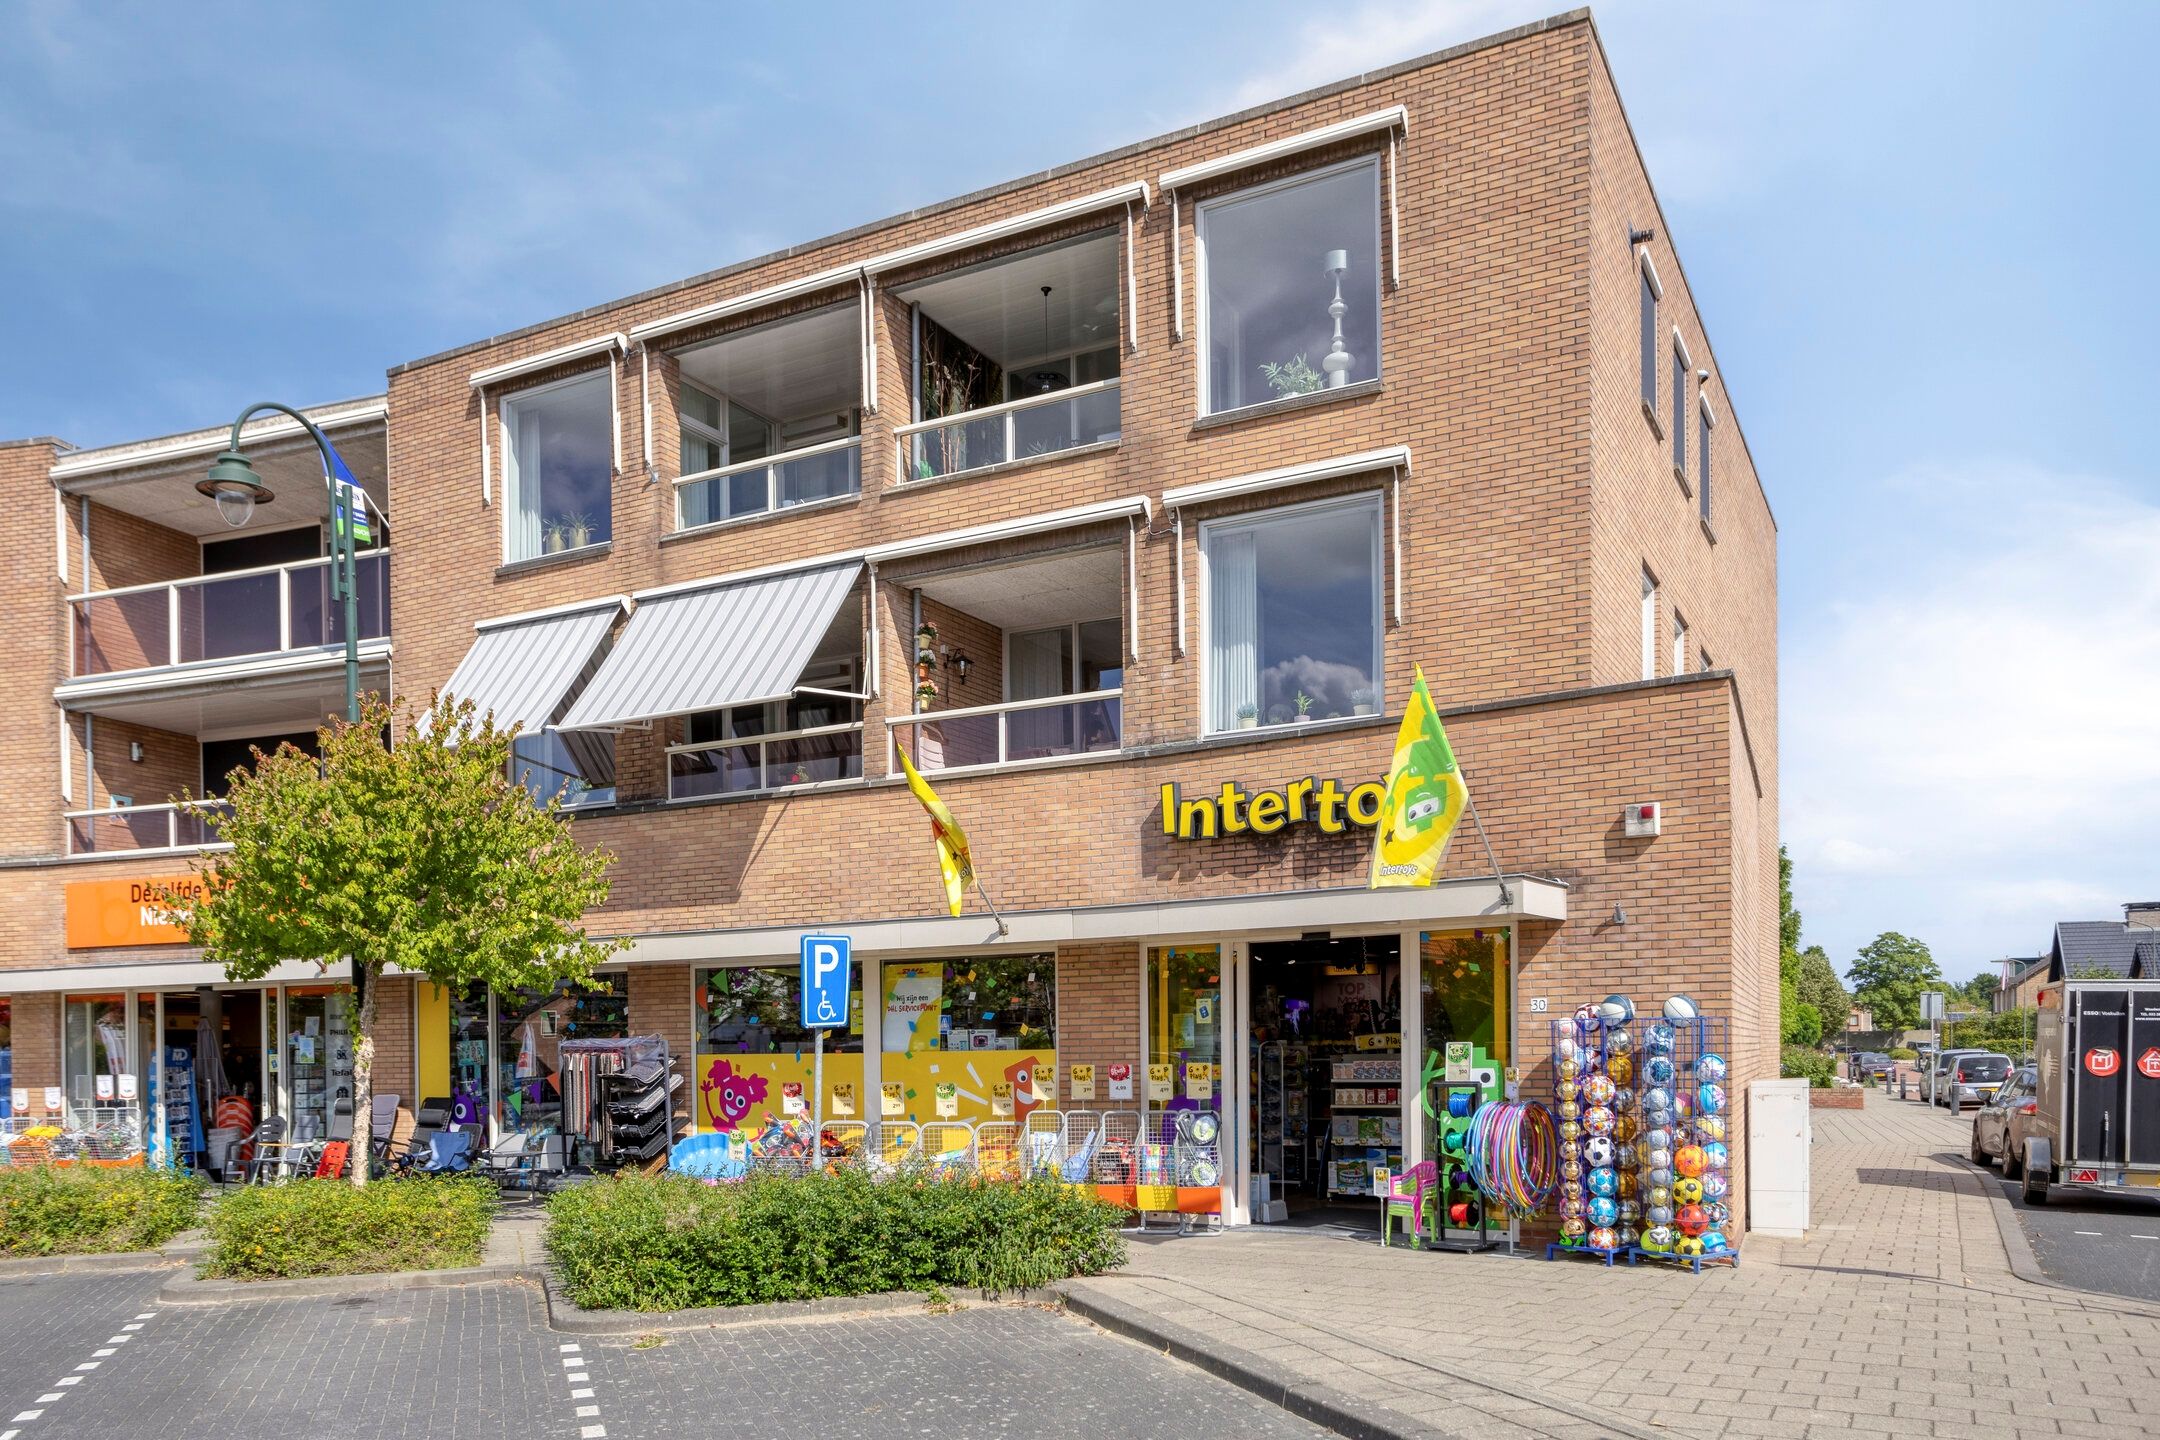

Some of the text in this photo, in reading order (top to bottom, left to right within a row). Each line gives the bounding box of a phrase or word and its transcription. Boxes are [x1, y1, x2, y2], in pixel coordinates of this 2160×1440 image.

[1160, 775, 1393, 839] Interto
[1380, 863, 1418, 877] Intertoys
[815, 945, 839, 989] P
[1337, 982, 1365, 996] TOP
[1532, 999, 1546, 1011] 30
